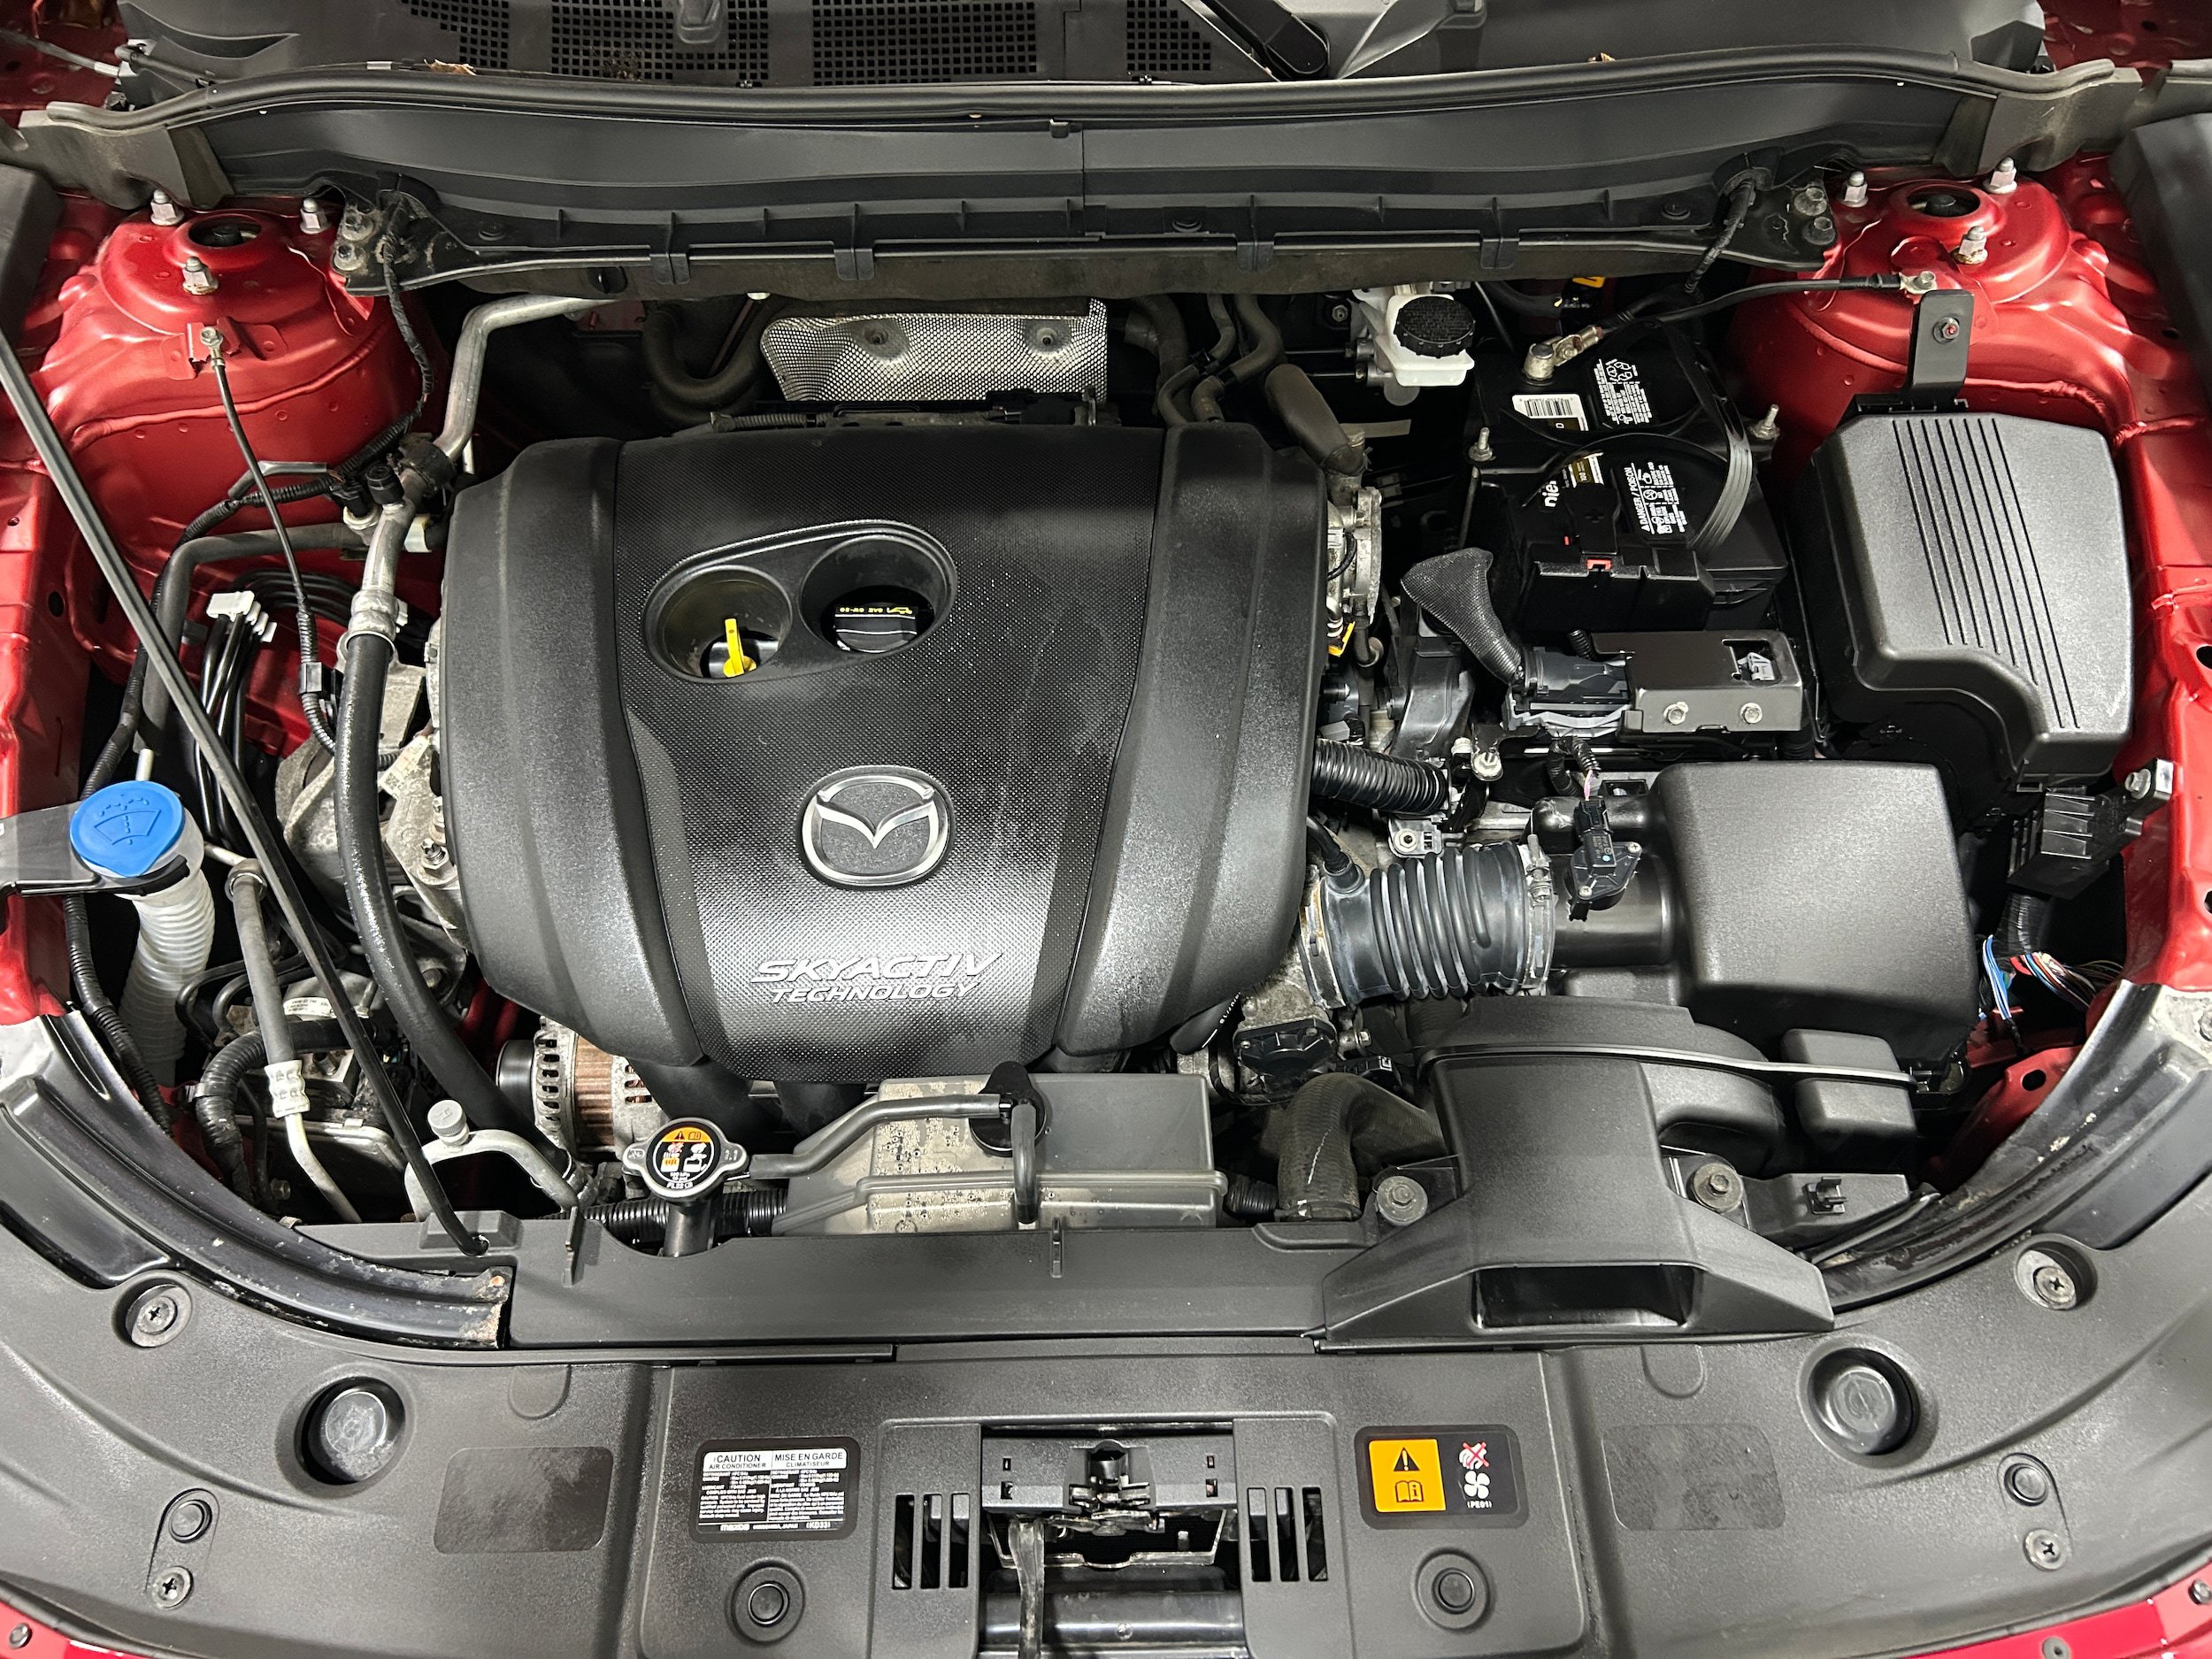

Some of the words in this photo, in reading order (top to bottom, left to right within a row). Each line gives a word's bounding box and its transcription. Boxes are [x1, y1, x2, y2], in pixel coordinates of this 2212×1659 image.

[1624, 467, 1639, 491] POISON
[1632, 497, 1649, 525] DANGER
[751, 953, 1003, 984] SKYACTIV
[770, 982, 981, 1003] TECHNOLOGY
[717, 1454, 761, 1463] CAUTION
[774, 1453, 796, 1462] MISE
